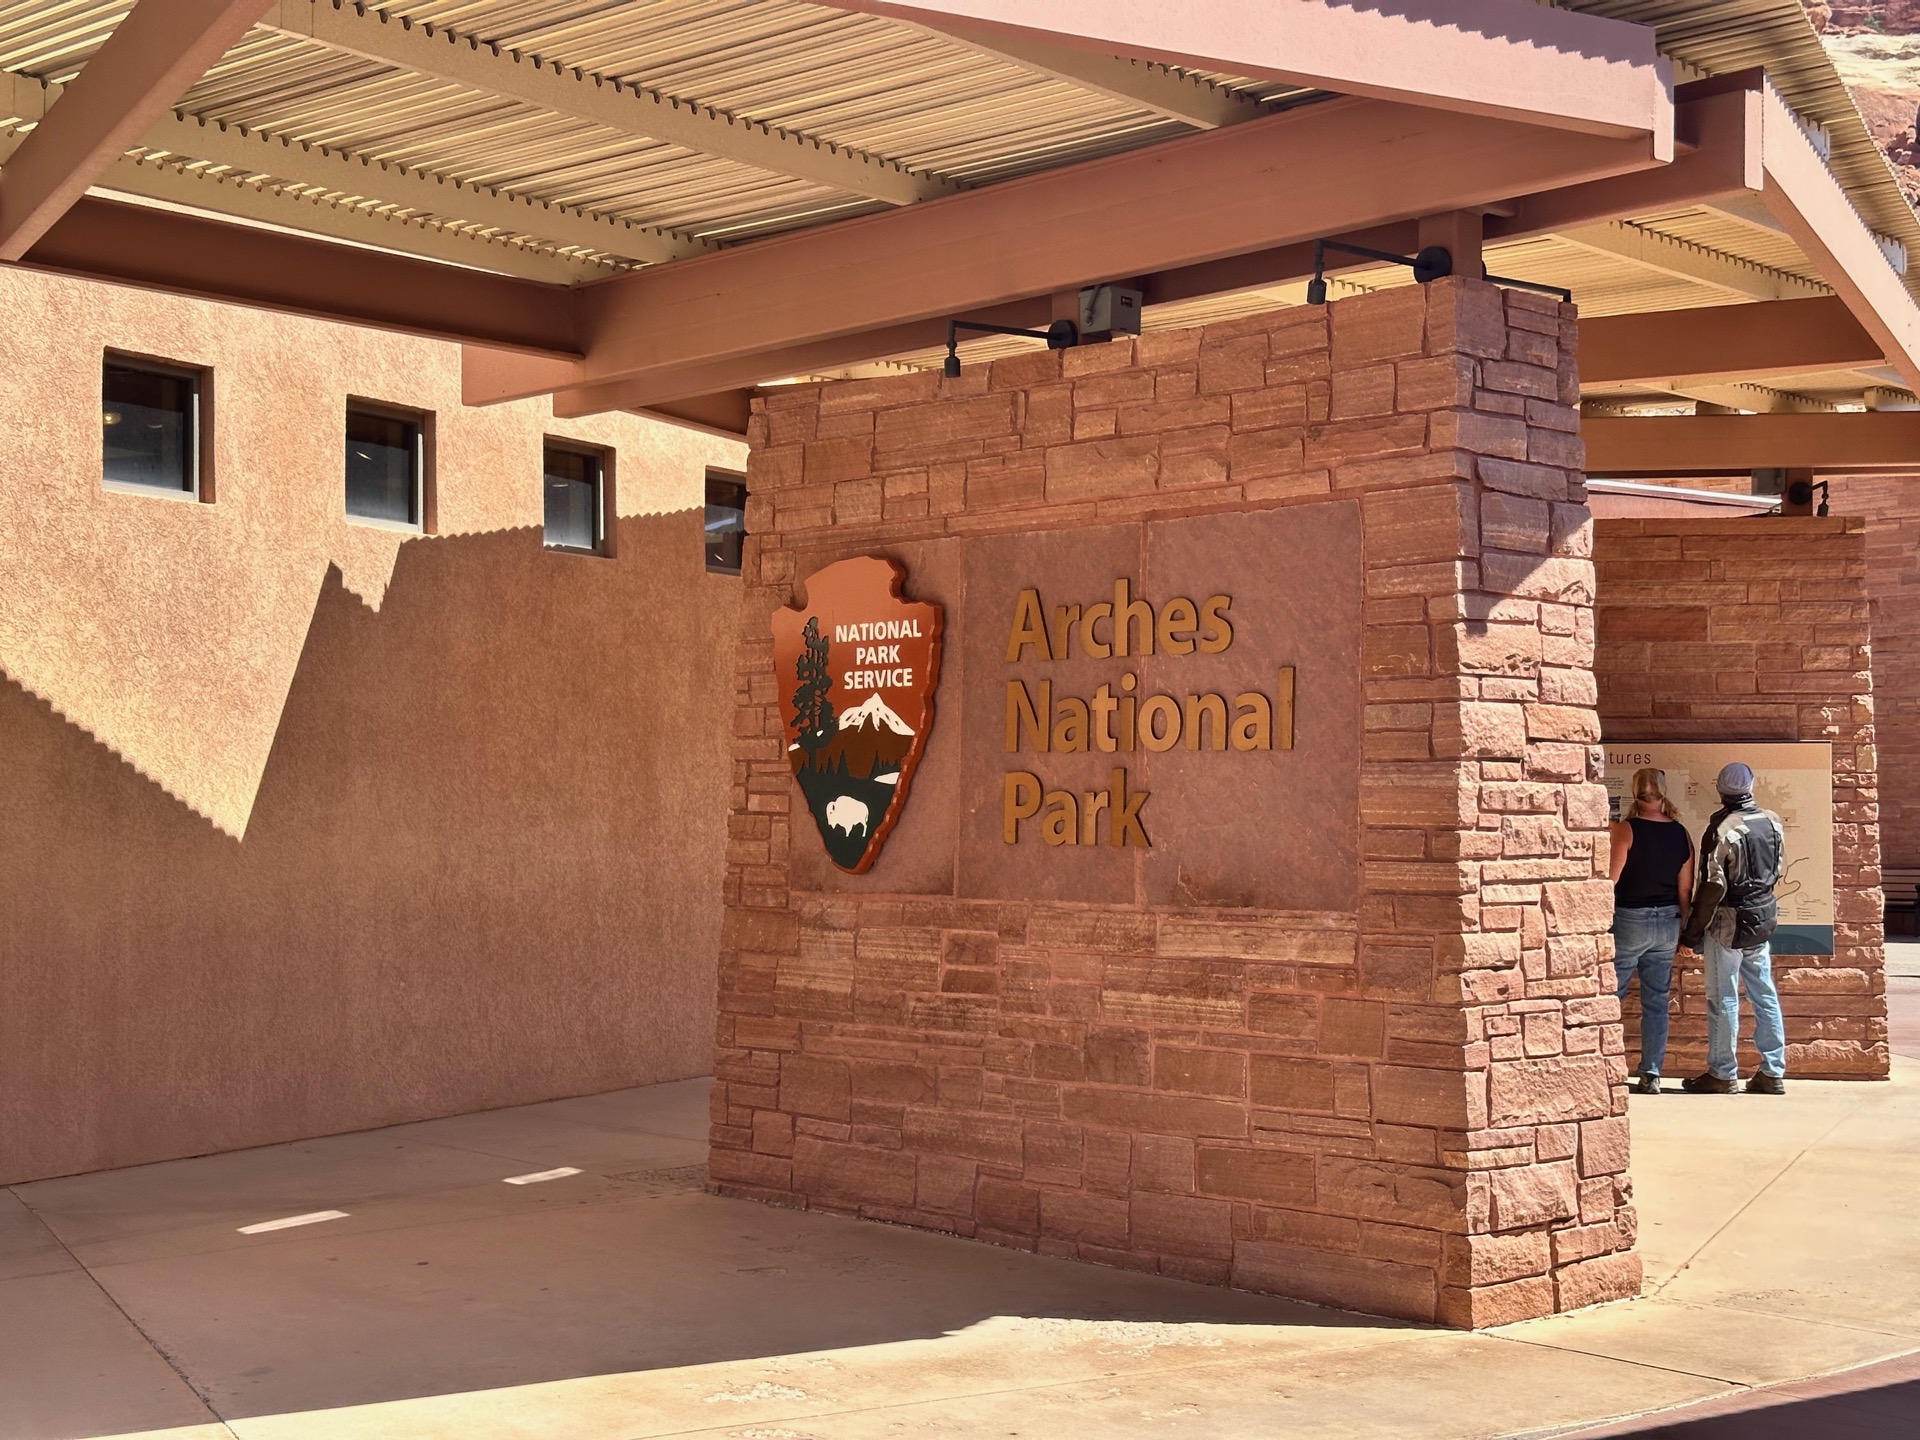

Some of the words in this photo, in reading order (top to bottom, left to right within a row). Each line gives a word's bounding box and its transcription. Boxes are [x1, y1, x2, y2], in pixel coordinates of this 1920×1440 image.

[835, 619, 922, 643] NATIONAL
[1006, 578, 1234, 662] Arches
[856, 645, 900, 665] PARK
[844, 668, 913, 690] SERVICE
[1005, 666, 1296, 753] National
[1605, 751, 1652, 765] tures
[1003, 767, 1153, 848] Park
